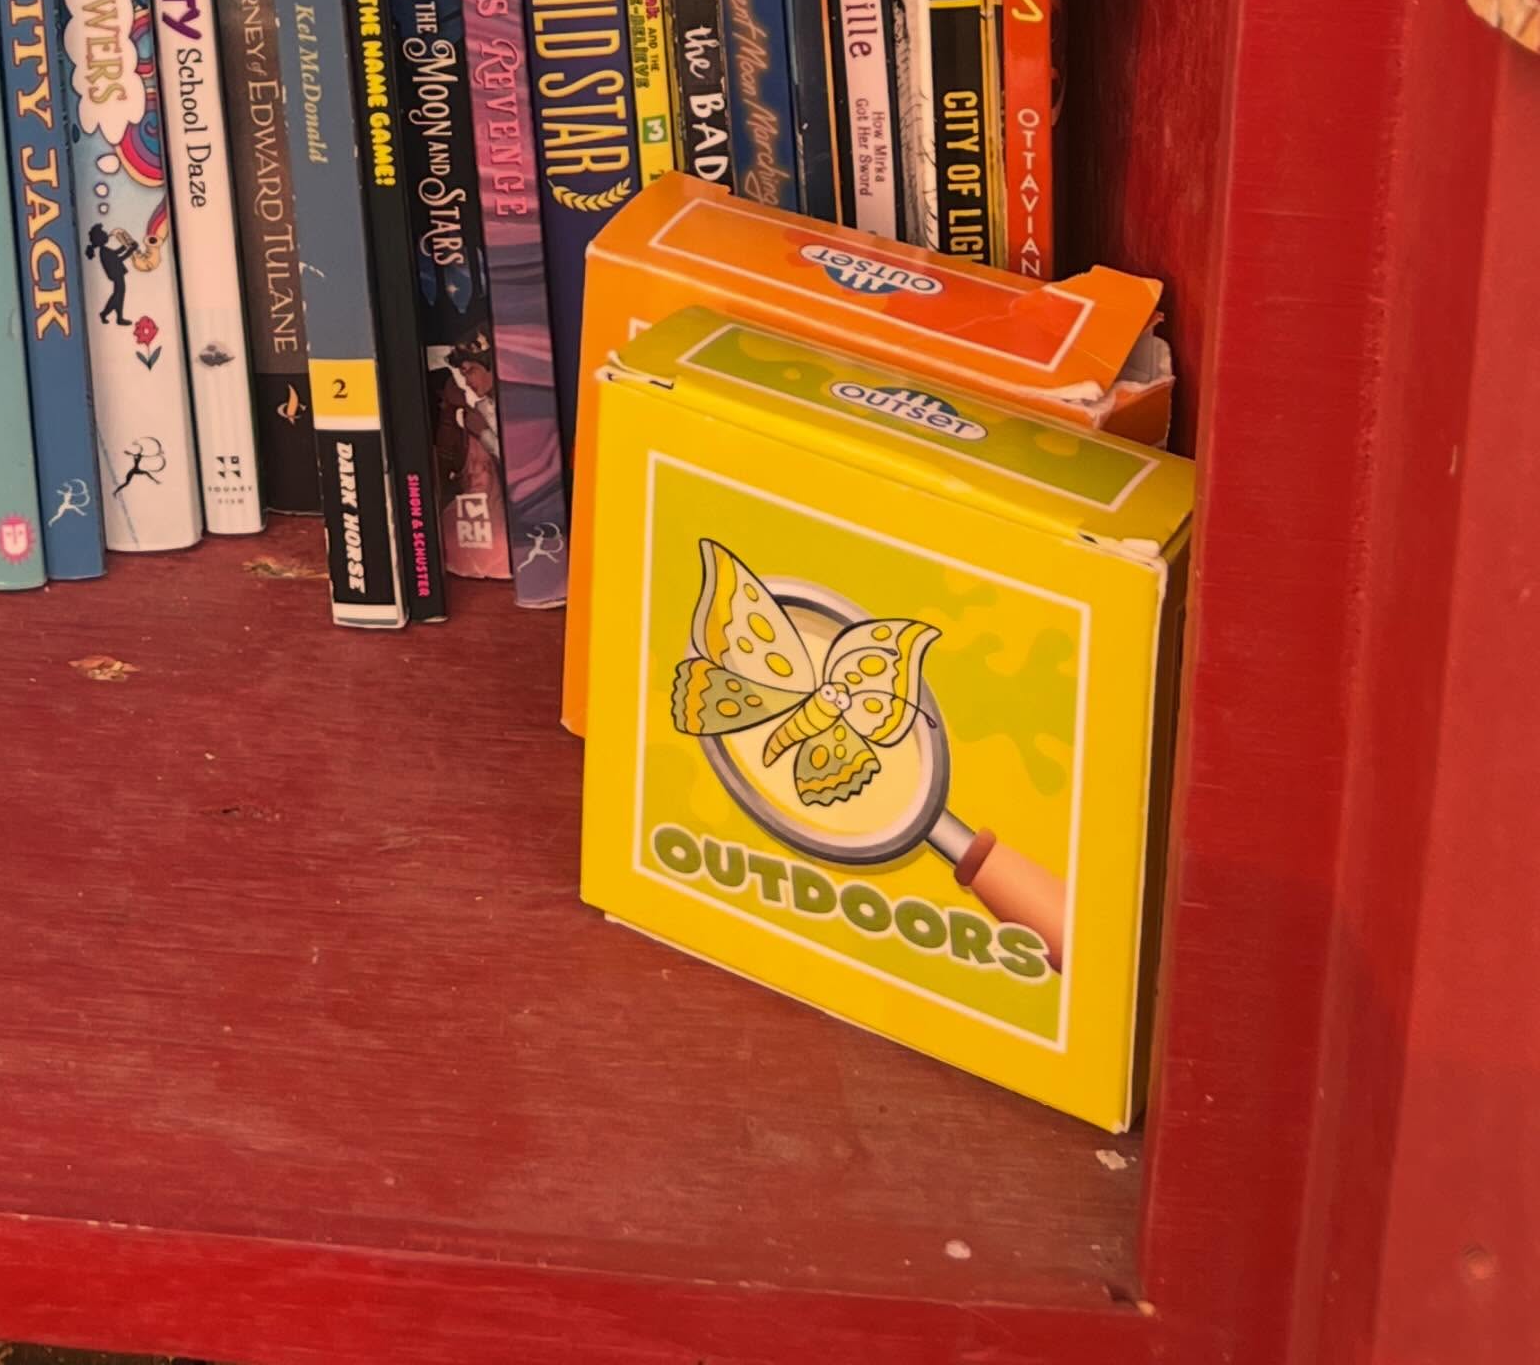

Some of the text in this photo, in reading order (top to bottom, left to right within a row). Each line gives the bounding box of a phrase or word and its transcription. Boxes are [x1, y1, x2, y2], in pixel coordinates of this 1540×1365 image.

[176, 48, 209, 134] School
[294, 3, 328, 164] Kel McDonald
[362, 40, 388, 108] NAME
[369, 112, 397, 187] GAME!
[537, 71, 631, 179] STAR
[187, 143, 211, 208] Daze
[20, 146, 72, 340] JACK
[332, 379, 348, 399] 2
[336, 441, 367, 595] DARK HORSE
[651, 823, 1053, 983] OUTDOORS
